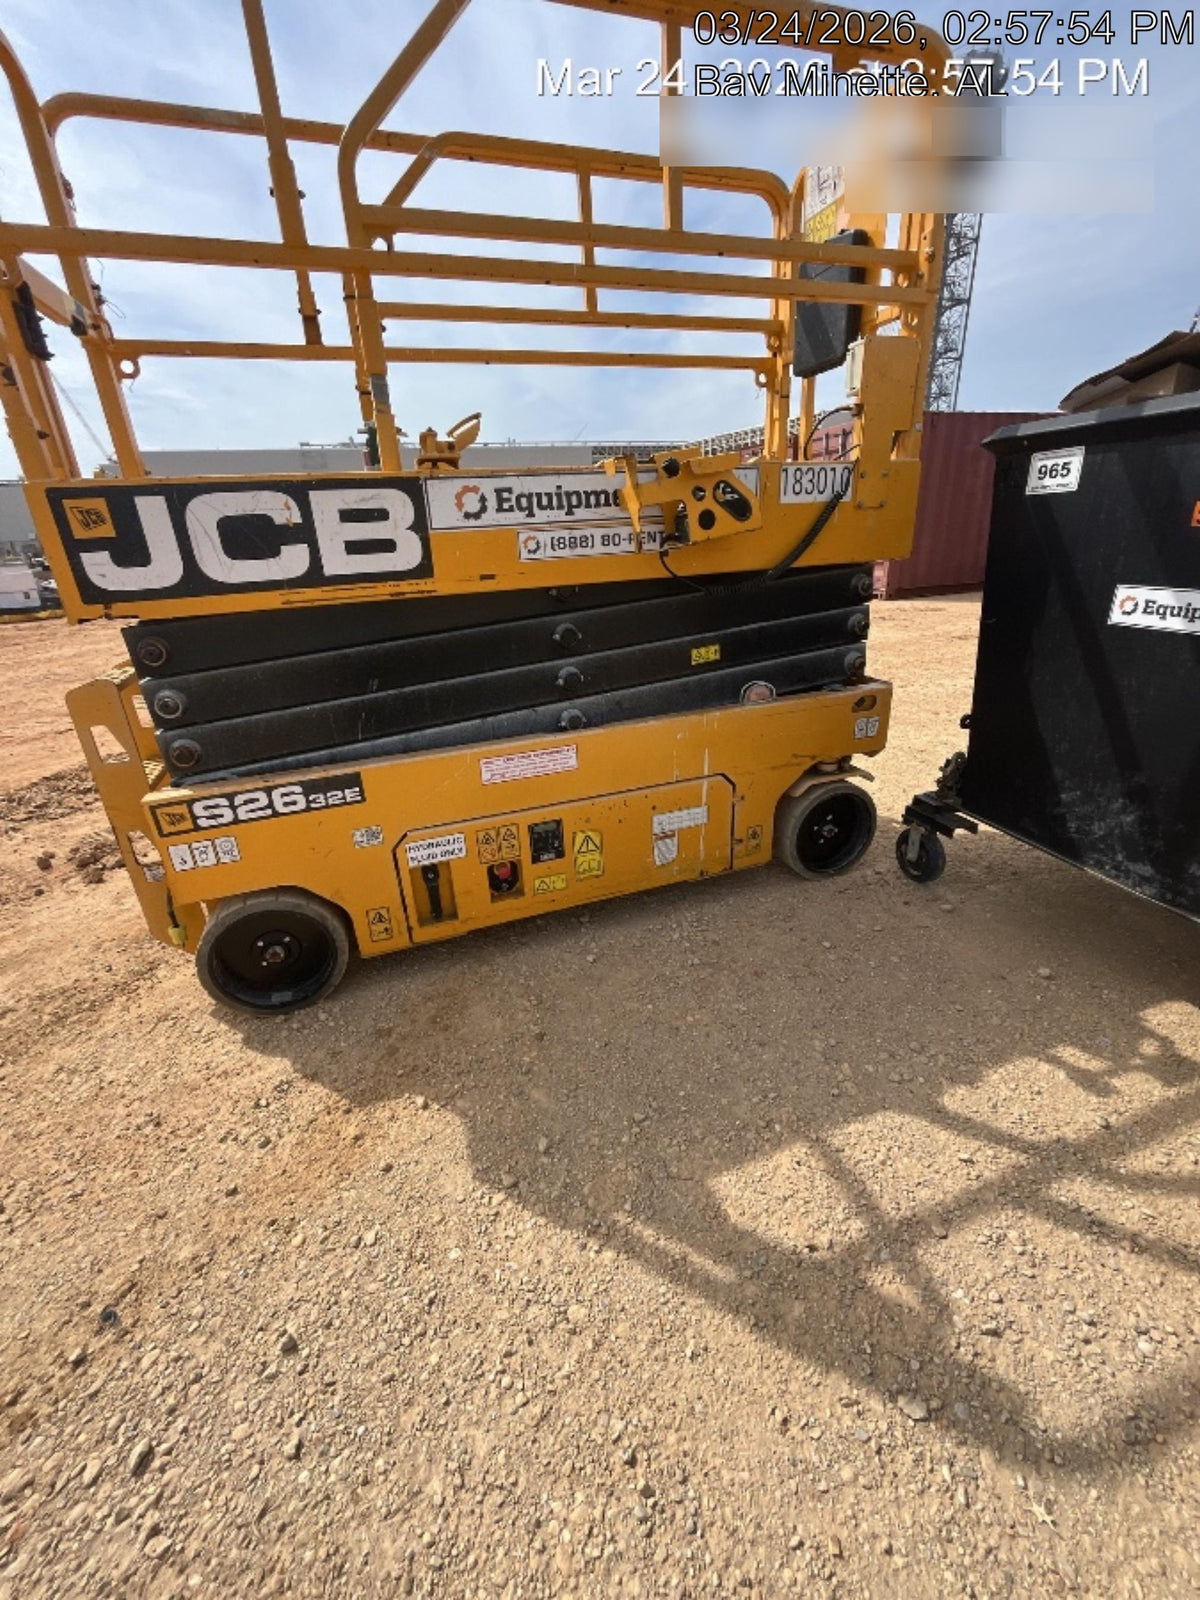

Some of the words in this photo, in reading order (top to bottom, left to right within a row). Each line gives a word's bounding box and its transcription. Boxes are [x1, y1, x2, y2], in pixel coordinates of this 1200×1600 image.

[782, 466, 852, 497] 183010
[1037, 461, 1072, 480] 965
[78, 488, 424, 591] JCB
[550, 534, 595, 551] (888)
[192, 784, 306, 828] S26
[308, 786, 362, 808] 32E
